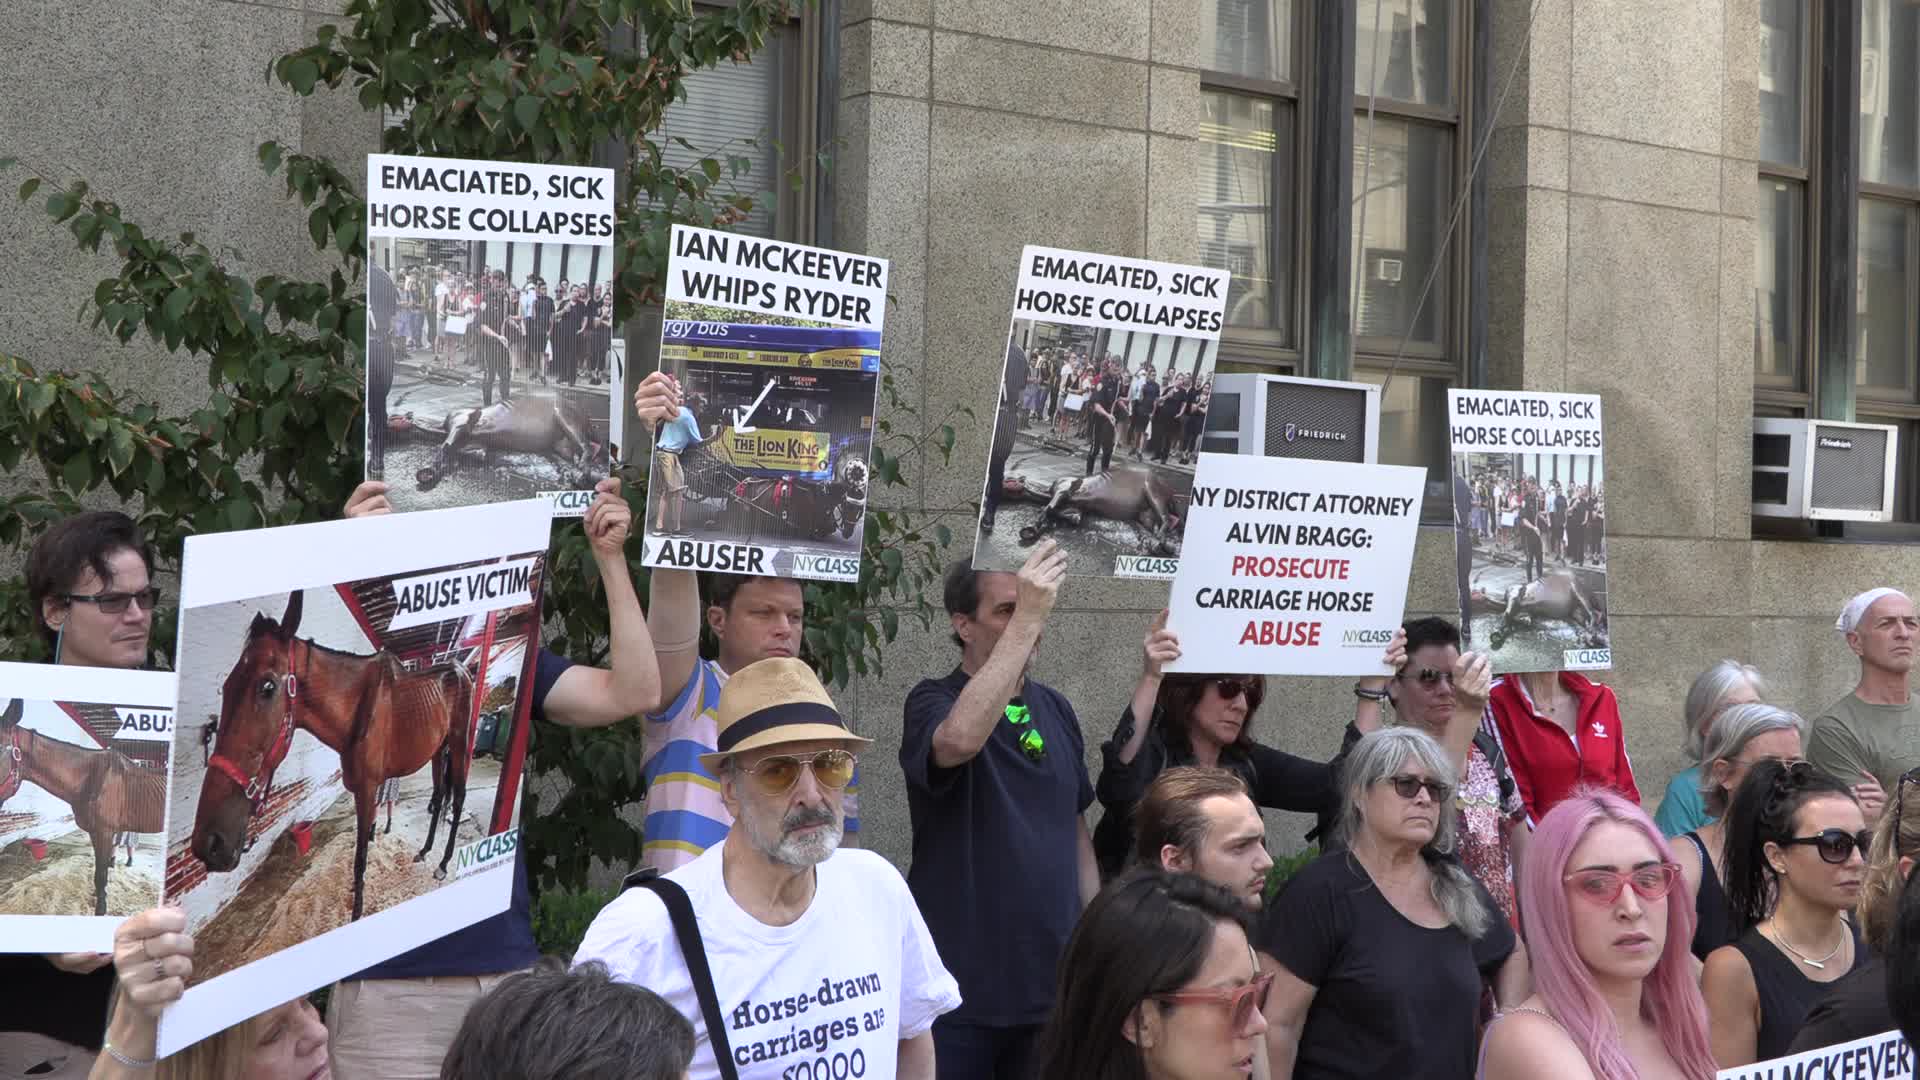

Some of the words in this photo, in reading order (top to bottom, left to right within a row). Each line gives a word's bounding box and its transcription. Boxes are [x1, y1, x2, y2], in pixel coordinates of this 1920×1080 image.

[381, 165, 539, 200] EMACIATED,
[546, 175, 605, 200] SICK
[370, 203, 461, 230] HORSE
[468, 208, 613, 237] COLLAPSES
[676, 230, 729, 263] IAN
[735, 239, 883, 289] MCKEEVER
[1031, 255, 1162, 296] EMACIATED,
[1169, 273, 1220, 298] SICK
[681, 269, 776, 309] WHIPS
[784, 285, 872, 324] RYDER
[1017, 288, 1094, 318] HORSE
[1098, 299, 1222, 332] COLLAPSES
[697, 321, 729, 337] bus
[1456, 396, 1554, 420] EMACIATED,
[1559, 401, 1596, 420] SICK
[734, 438, 754, 451] THE
[1298, 429, 1346, 440] FRIEDRICH
[1452, 426, 1507, 445] HORSE
[1511, 428, 1601, 448] COLLAPSES
[1190, 487, 1221, 507] NY
[1223, 488, 1310, 512] DISTRICT
[1313, 493, 1414, 517] ATTORNEY
[1225, 522, 1291, 546] ALVIN
[1295, 525, 1373, 548] BRAGG:
[655, 539, 764, 573] ABUSER
[793, 553, 859, 575] NYCLASS
[1116, 557, 1179, 574] NYCLASS
[1231, 556, 1350, 580] PROSECUTE
[396, 577, 462, 616] ABUSE
[467, 565, 529, 602] VICTIM
[1195, 588, 1303, 611] CARRIAGE
[1306, 592, 1374, 612] HORSE
[1239, 621, 1322, 647] ABUSE
[1343, 629, 1392, 642] NYCLASS
[1564, 650, 1609, 664] NYCLASS
[456, 829, 518, 871] NYCLASS
[732, 972, 881, 1030] Horse-drawn
[734, 1016, 859, 1066] carriages
